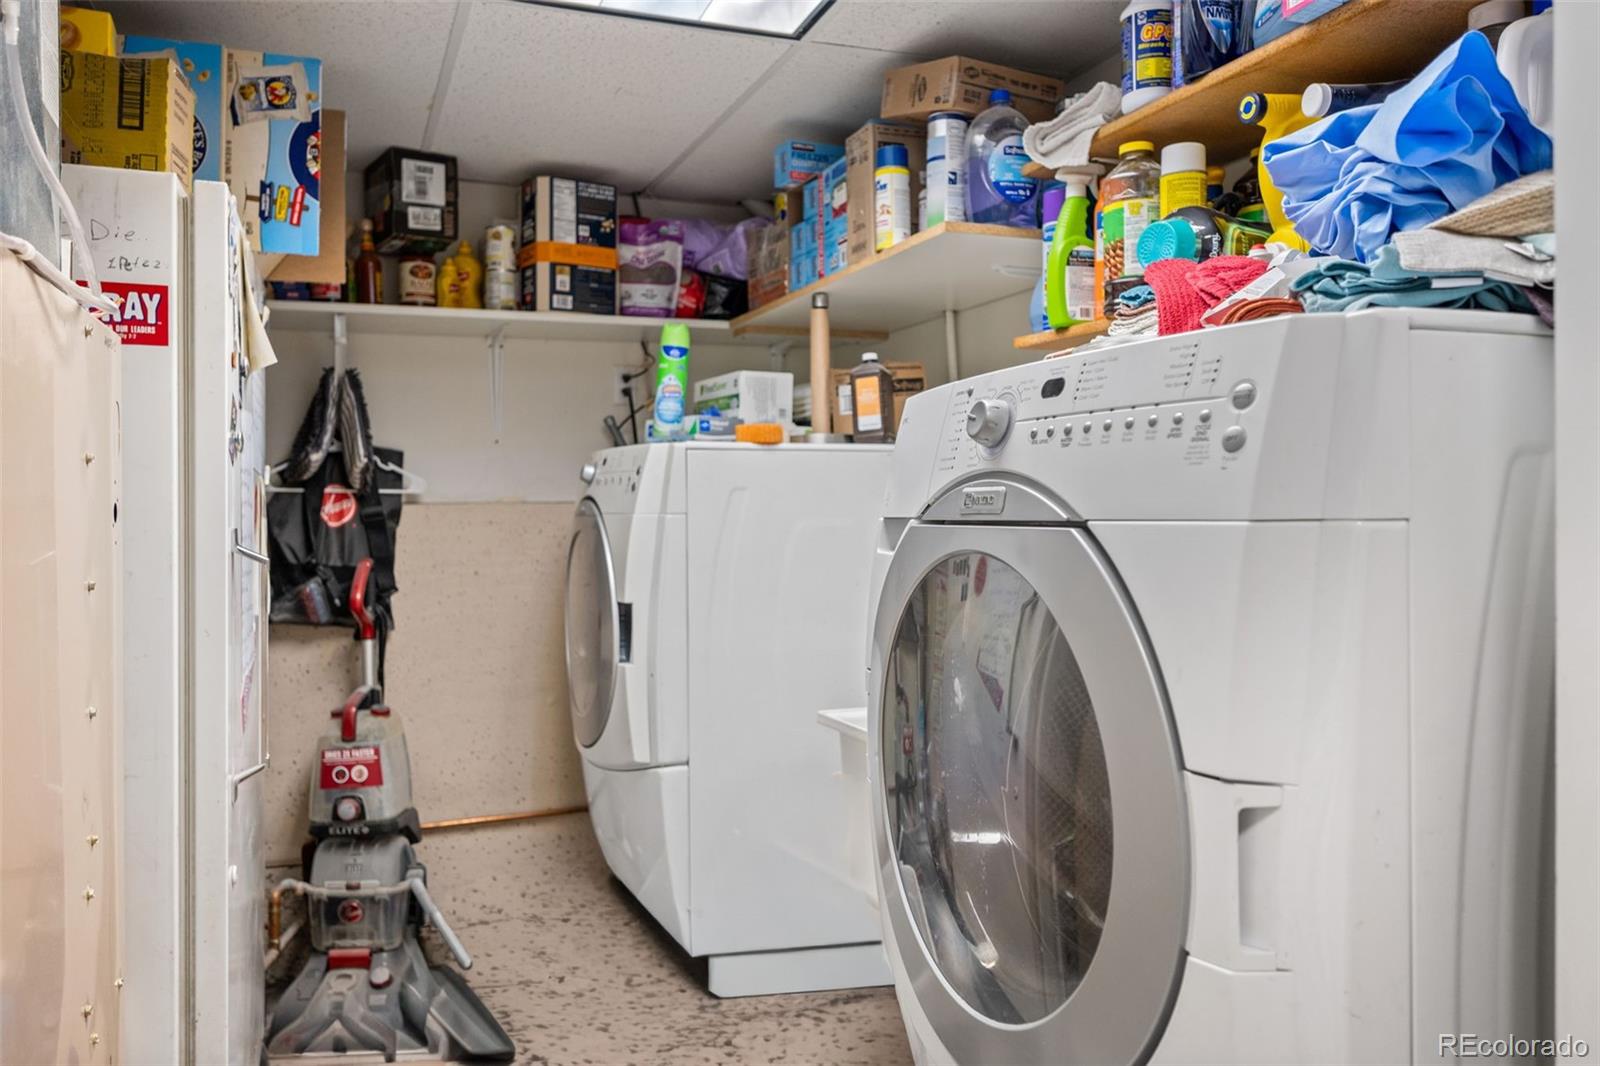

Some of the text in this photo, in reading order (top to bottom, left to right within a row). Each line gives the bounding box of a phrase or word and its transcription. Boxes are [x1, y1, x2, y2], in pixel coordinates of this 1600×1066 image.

[1209, 233, 1221, 258] Downy
[102, 291, 161, 325] RAY
[115, 324, 156, 335] OUR LEADERS
